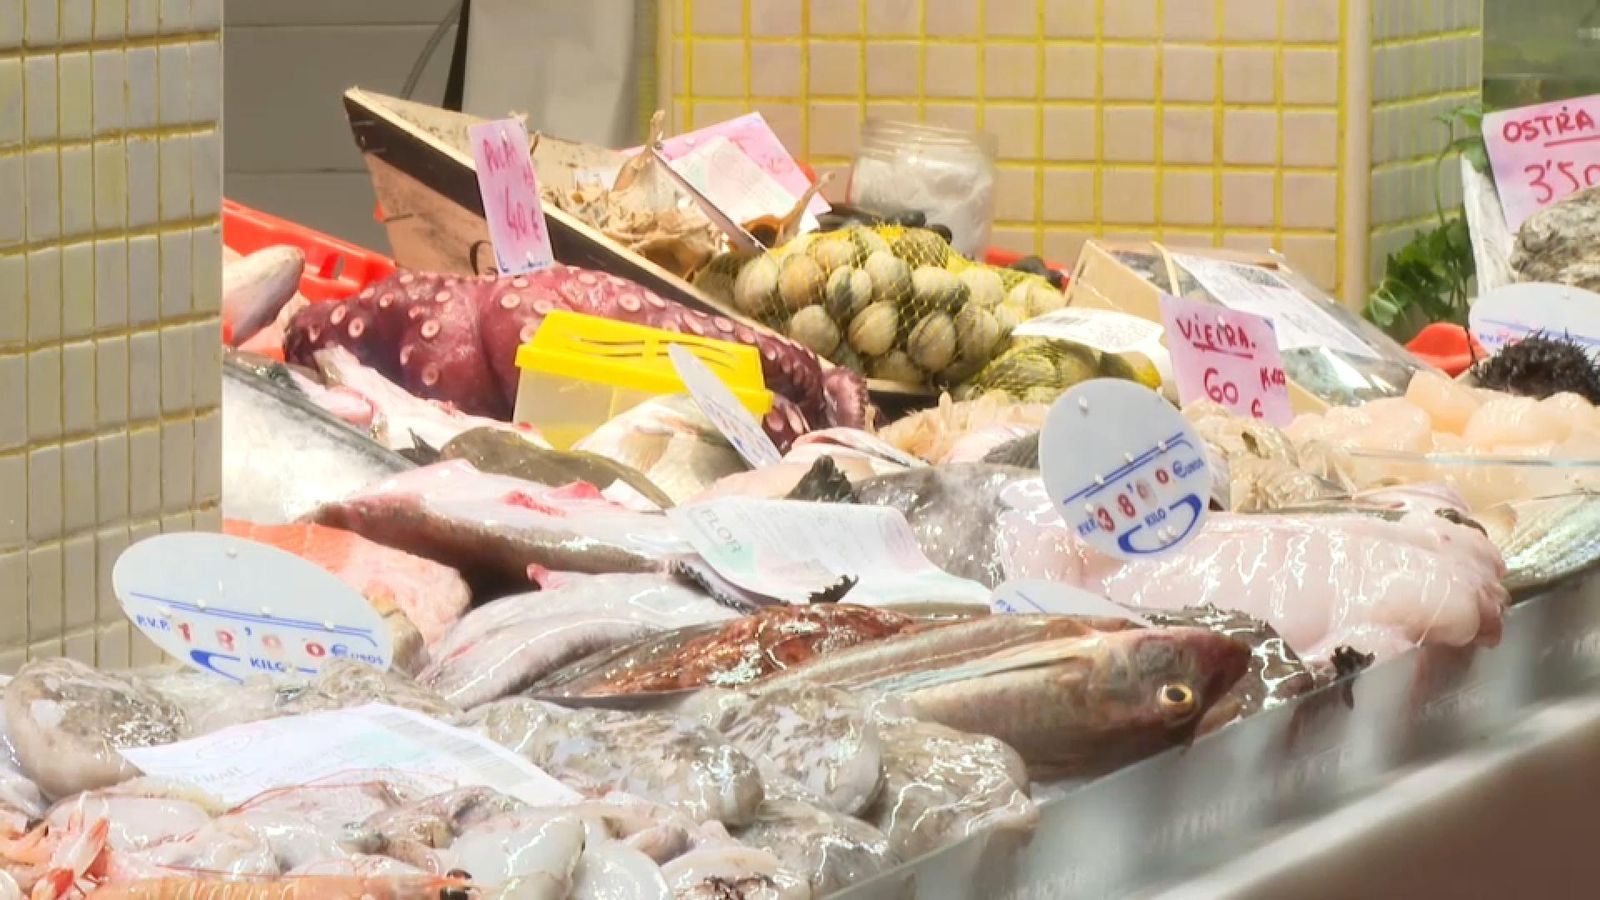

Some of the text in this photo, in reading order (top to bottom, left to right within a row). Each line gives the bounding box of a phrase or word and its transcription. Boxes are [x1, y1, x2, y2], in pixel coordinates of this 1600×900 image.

[1503, 109, 1595, 142] OSTRA
[1203, 367, 1239, 405] 60
[1144, 507, 1167, 528] KILO
